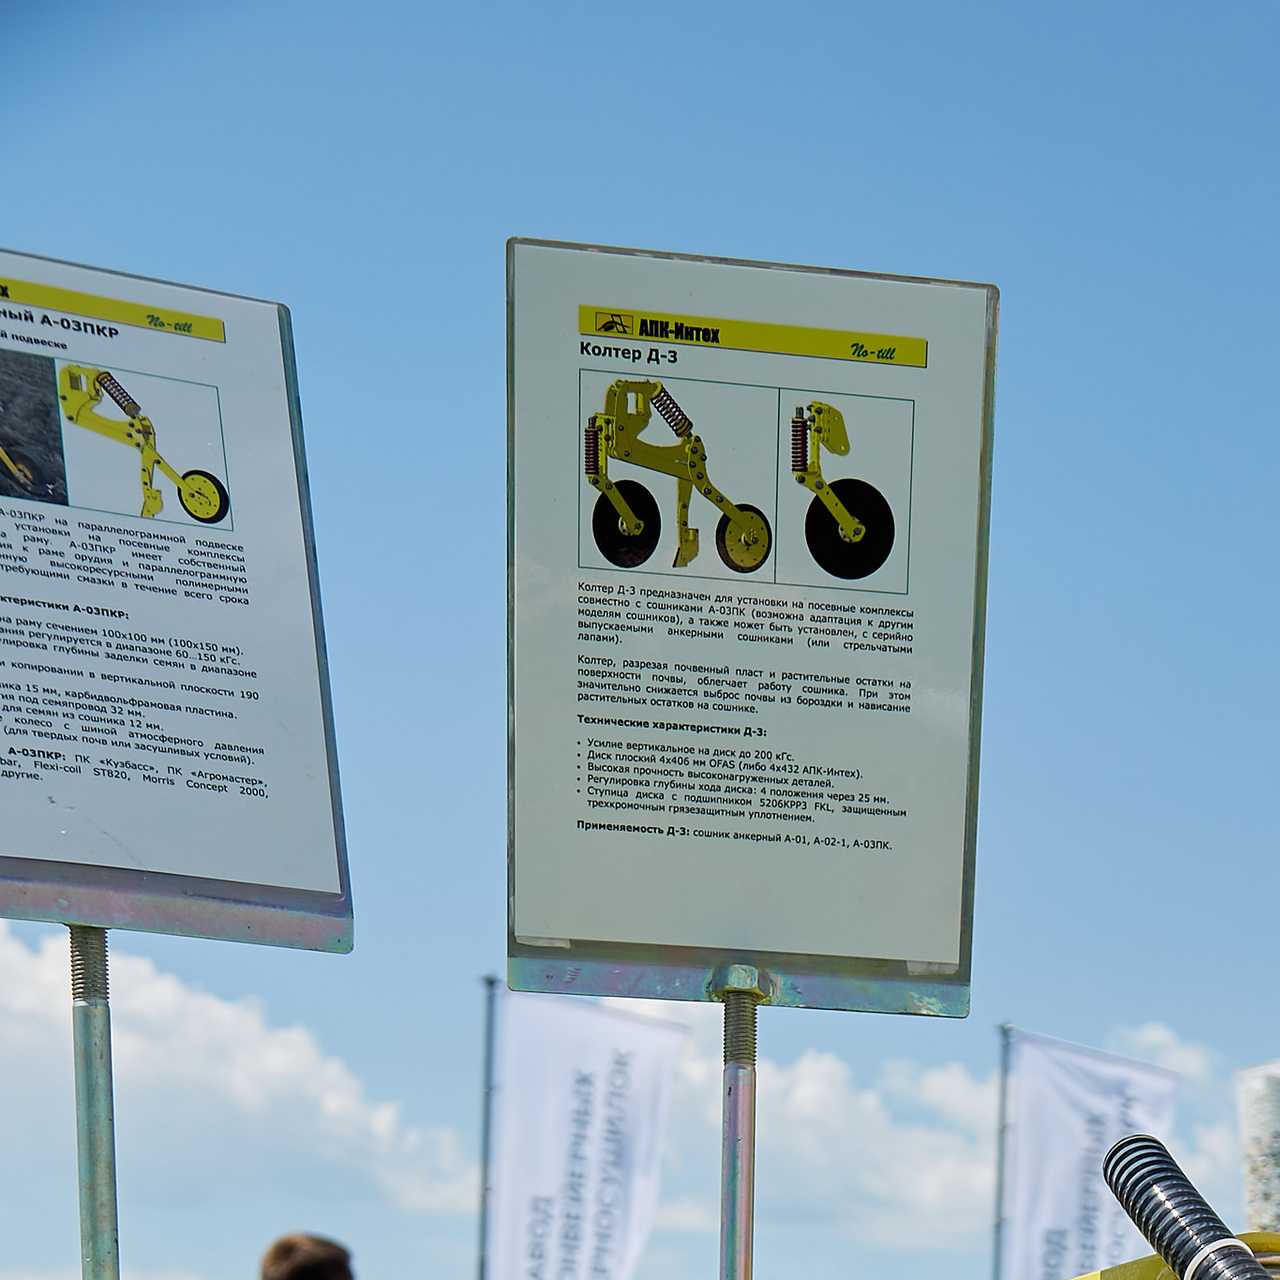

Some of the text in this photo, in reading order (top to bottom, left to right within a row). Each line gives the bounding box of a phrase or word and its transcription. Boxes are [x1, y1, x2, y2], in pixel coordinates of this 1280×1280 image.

[145, 313, 193, 334] No-till
[638, 318, 721, 344] АПК-Интех
[11, 333, 68, 350] подвеске
[579, 341, 642, 363] Колтер
[850, 342, 896, 360] No-till
[14, 522, 245, 562] установки на посевные комплексы
[54, 518, 68, 526] на
[77, 521, 186, 544] параллелограммной
[195, 539, 243, 552] подвеске
[577, 581, 614, 595] Колтер
[639, 588, 711, 601] предназначен
[713, 594, 732, 603] для
[736, 596, 788, 607] установки
[791, 600, 803, 609] на
[807, 601, 856, 613] посевные
[859, 606, 913, 617] комплексы
[577, 595, 630, 607] совместно
[634, 600, 641, 608] с
[645, 601, 703, 613] сошниками
[751, 607, 804, 621] (возможна
[809, 614, 862, 626] адаптация
[867, 618, 873, 627] к
[877, 619, 913, 630] другим
[577, 607, 913, 642] моделям сошников), а также может быть установлен, с серийно
[577, 620, 912, 653] выпускаемыми анкерными сошниками (или стрельчатыми
[577, 632, 622, 645] лапами).
[577, 654, 616, 668] Колтер,
[622, 659, 668, 670] разрезая
[674, 663, 729, 675] почвенный
[735, 668, 763, 677] пласт
[781, 671, 850, 684] растительные
[855, 677, 893, 687] остатки
[577, 668, 910, 700] поверхности почвы, облегчает работу сошника. При этом
[576, 680, 641, 692] значительно
[645, 685, 698, 696] снижается
[703, 688, 740, 701] выброс
[744, 693, 775, 702] почвы
[780, 696, 791, 704] из
[796, 695, 842, 707] бороздки
[858, 701, 910, 712] нависание
[577, 692, 758, 713] растительных остатков на сошнике.
[1, 704, 163, 731] для семян из сошника 12 мм.
[576, 713, 649, 728] Технические
[652, 721, 740, 735] характеристики
[3, 724, 254, 765] (для твердых почв или засушливых условий).
[587, 737, 623, 749] Усилие
[626, 742, 695, 754] вертикальное
[697, 747, 710, 755] на
[712, 748, 736, 757] диск
[738, 750, 751, 759] до
[753, 749, 772, 763] 200
[0, 769, 43, 780] другие.
[33, 760, 268, 798] Flexi-coil ST820, Morris Concept 2000,
[74, 753, 90, 764] ПК
[99, 757, 158, 774] «Кузбасс»,
[167, 765, 182, 776] ПК
[190, 769, 267, 787] «Агромастер»,
[586, 749, 612, 760] Диск
[614, 753, 656, 763] плоский
[692, 758, 706, 767] мм
[708, 758, 735, 769] OFAS
[738, 760, 766, 772] (либо
[801, 765, 862, 780] АПК-Интех).
[587, 761, 834, 788] Высокая прочность высоконагруженных деталей.
[586, 785, 628, 798] Ступица
[634, 790, 664, 800] диска
[671, 793, 677, 801] с
[683, 794, 752, 806] подшипником
[814, 801, 834, 813] FKL,
[841, 805, 906, 816] защищенным
[587, 773, 889, 804] Регулировка глубины хода диска: 4 положения через 25 мм.
[586, 799, 815, 822] трехкромочным грязезащитным уплотнением.
[576, 819, 664, 834] Применяемость
[692, 829, 730, 838] сошник
[732, 831, 781, 842] анкерный
